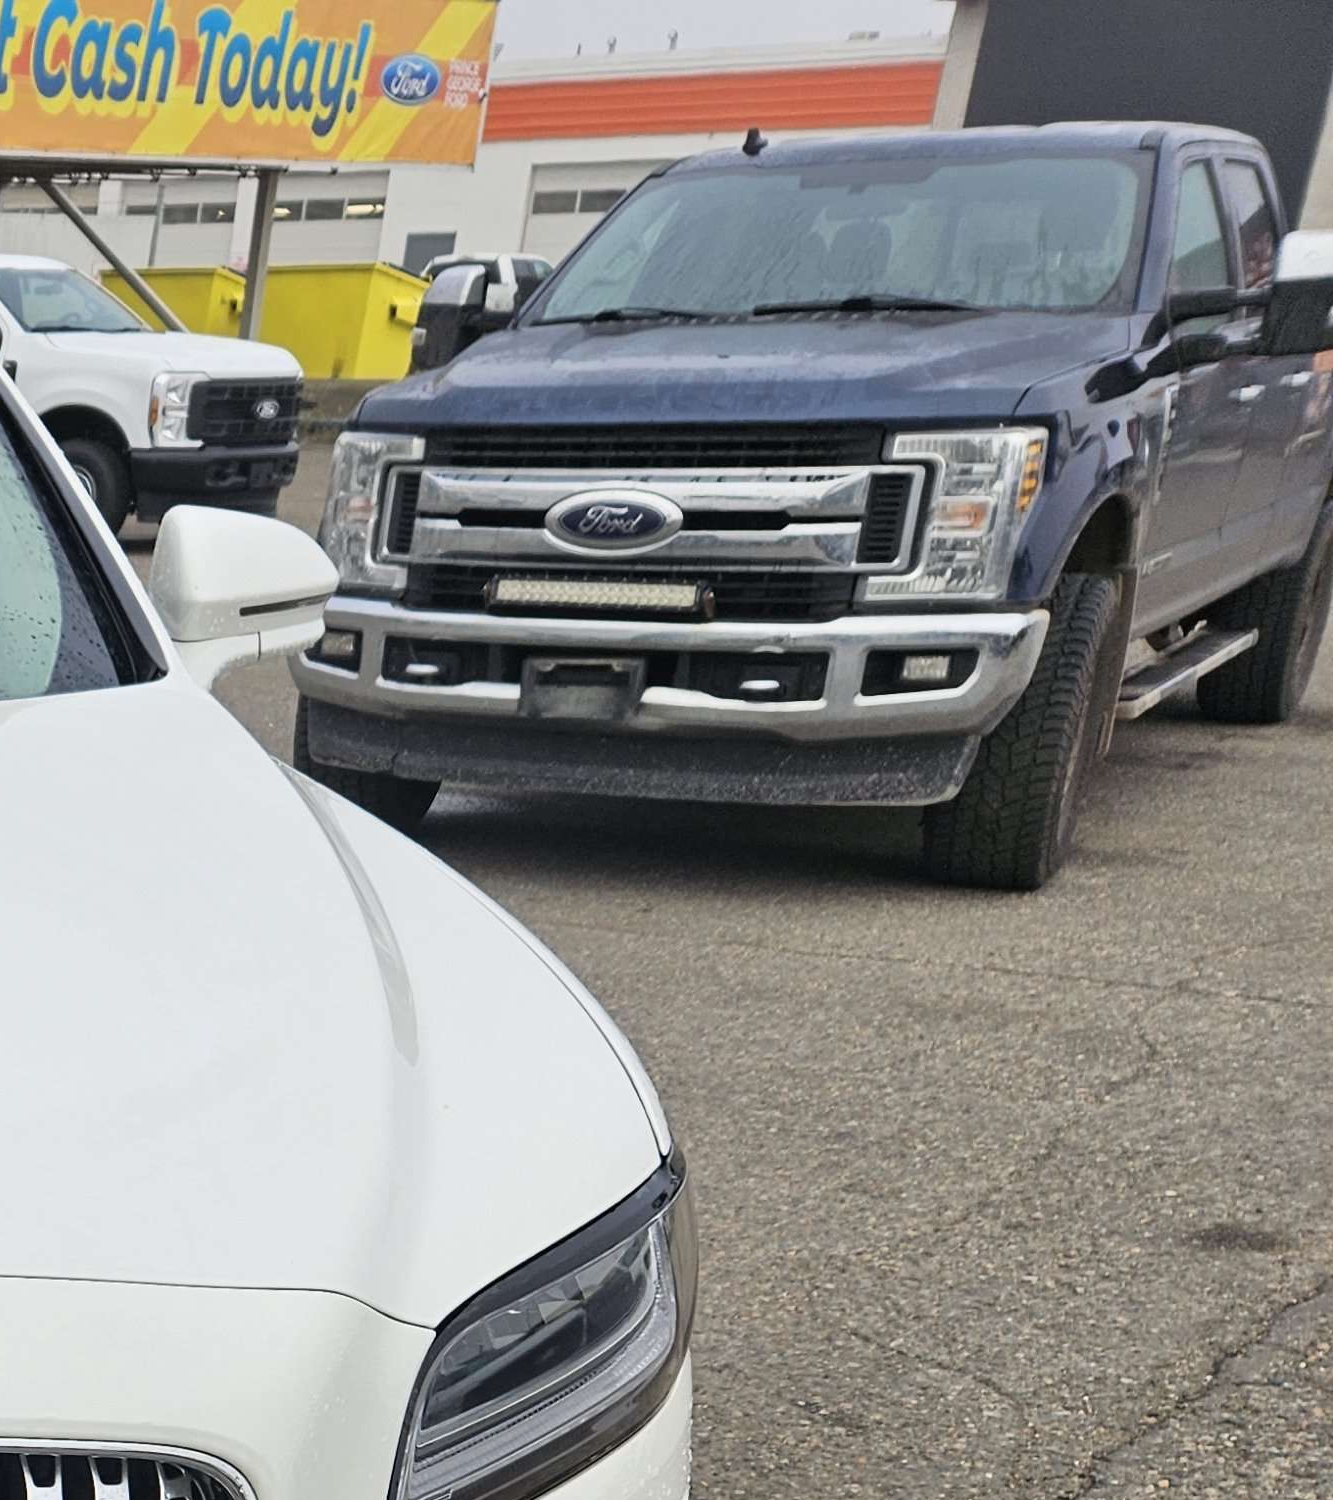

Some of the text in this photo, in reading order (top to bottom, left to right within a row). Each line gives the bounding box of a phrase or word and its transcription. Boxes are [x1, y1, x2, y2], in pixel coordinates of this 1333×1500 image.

[33, 0, 179, 103] Cash
[195, 8, 372, 137] Today!
[390, 59, 431, 97] Ford
[579, 504, 645, 534] Ford
